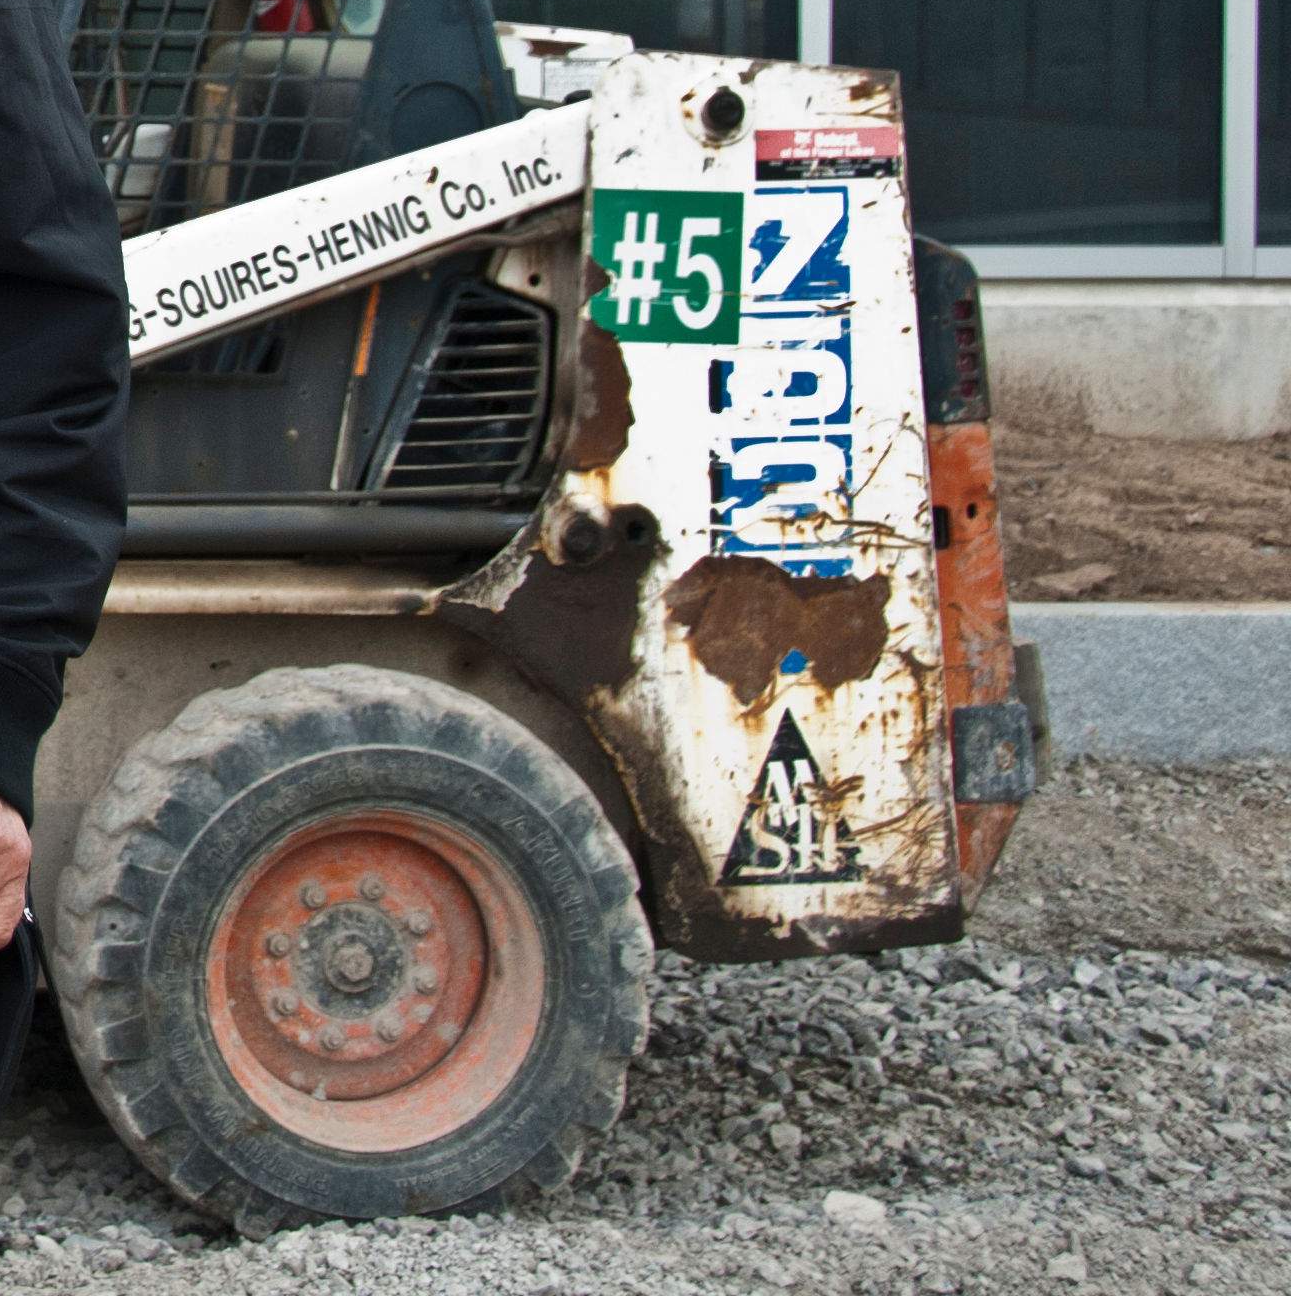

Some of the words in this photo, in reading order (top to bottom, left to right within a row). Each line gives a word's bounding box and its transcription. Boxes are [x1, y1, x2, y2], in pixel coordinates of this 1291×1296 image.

[440, 180, 496, 220] Co.
[501, 157, 562, 197] Inc.
[613, 211, 724, 331] #5
